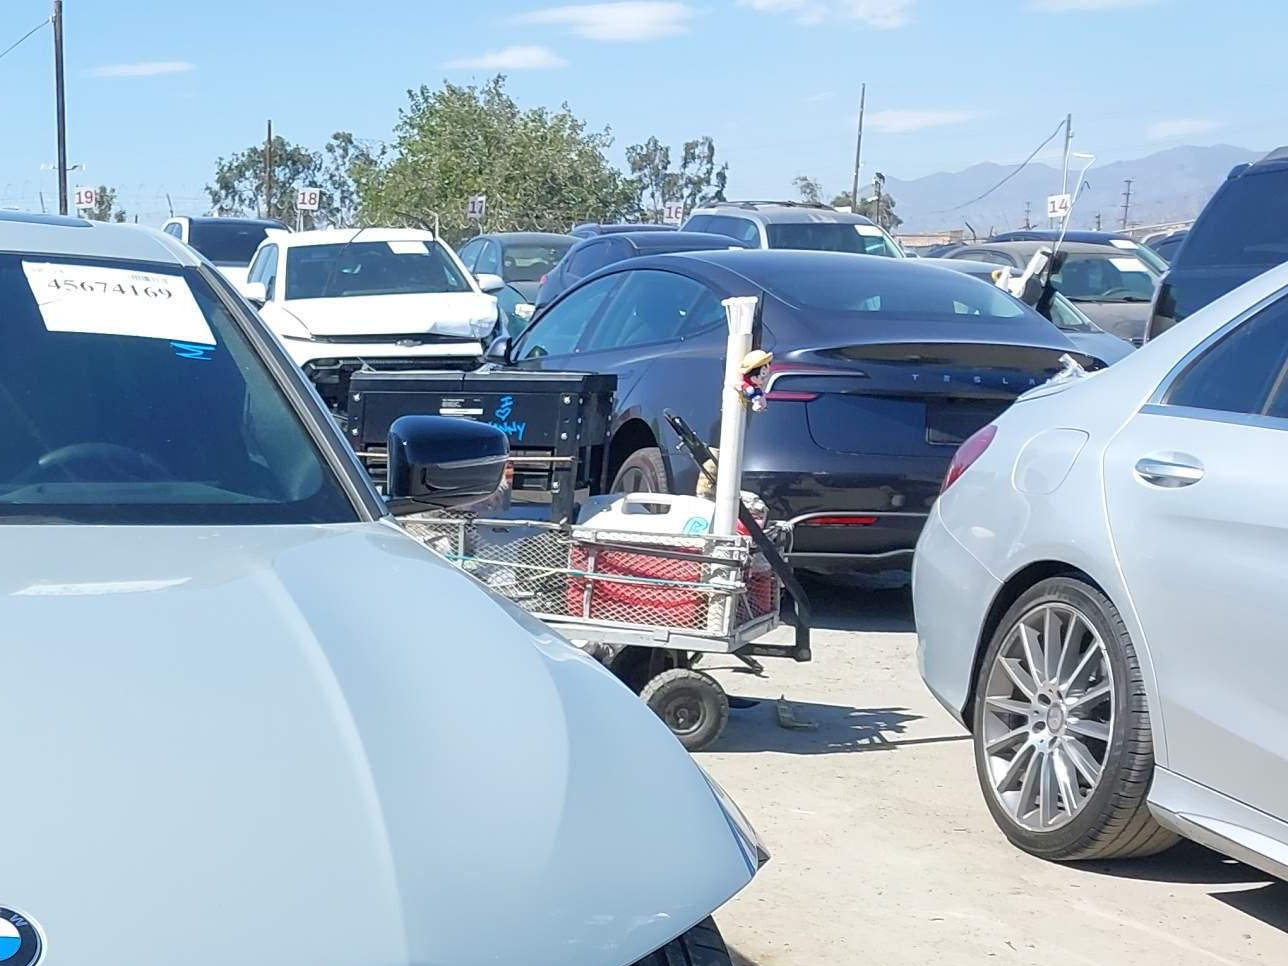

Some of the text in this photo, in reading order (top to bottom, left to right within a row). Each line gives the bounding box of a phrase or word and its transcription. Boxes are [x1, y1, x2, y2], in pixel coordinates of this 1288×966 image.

[75, 190, 94, 205] 19
[298, 191, 318, 206] 18
[1048, 198, 1069, 214] 14
[47, 278, 173, 300] 45674169
[911, 373, 1036, 385] TESLA
